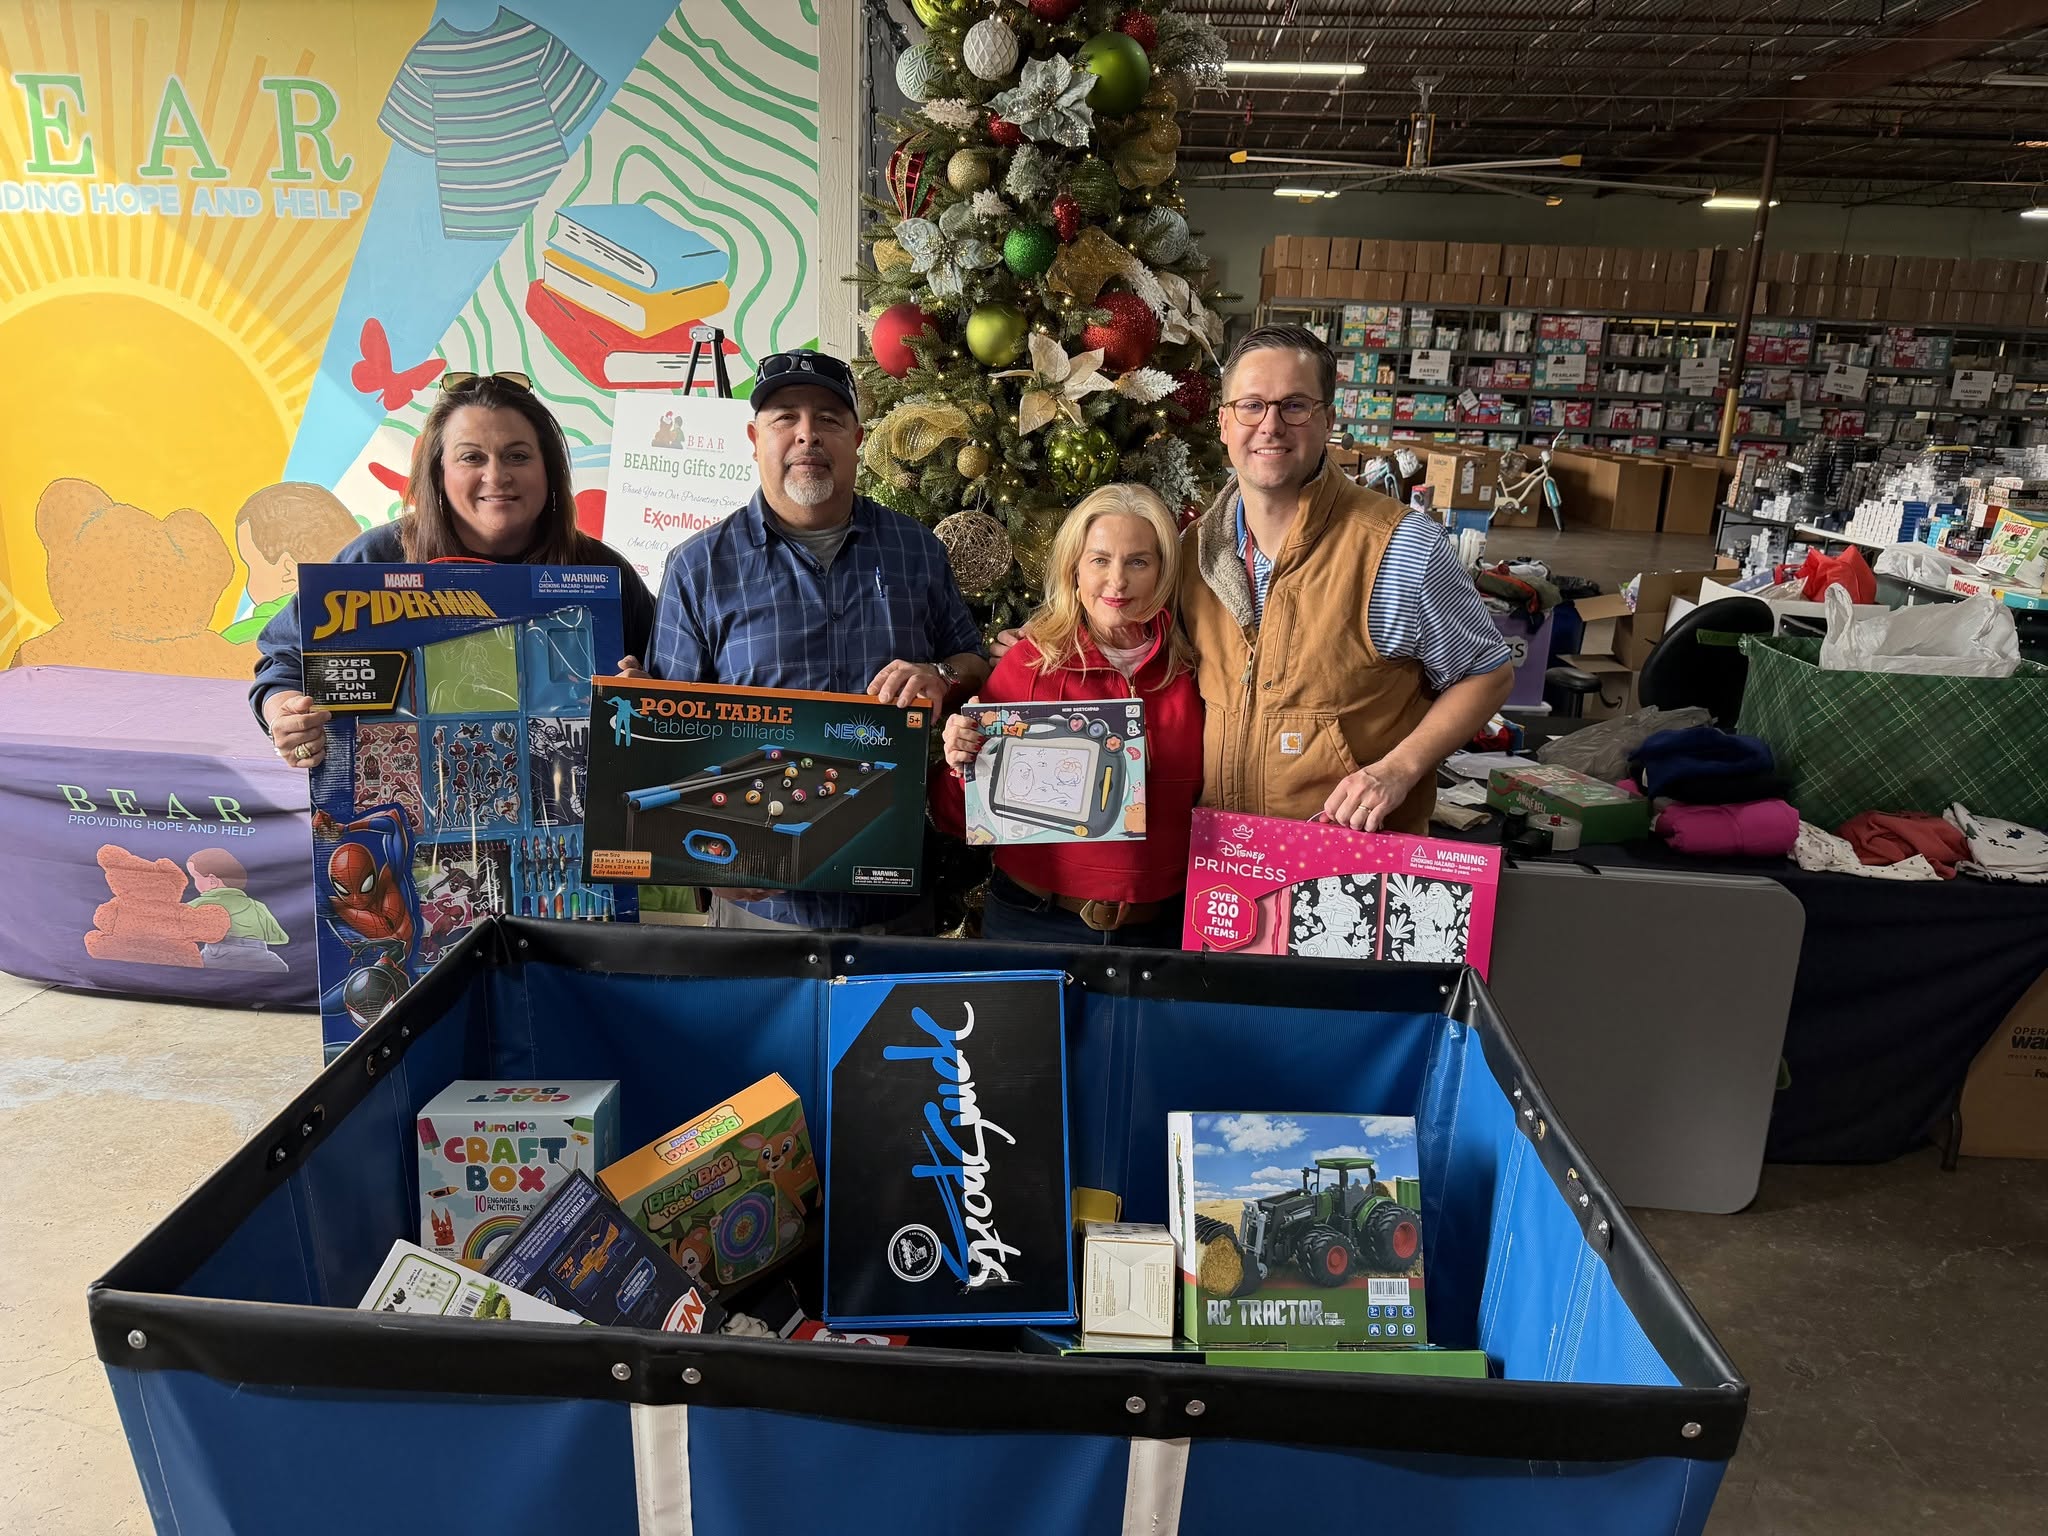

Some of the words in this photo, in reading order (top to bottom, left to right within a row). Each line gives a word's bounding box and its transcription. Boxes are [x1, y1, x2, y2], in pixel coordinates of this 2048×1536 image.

[90, 182, 181, 216] HOPE
[192, 186, 262, 218] AND
[274, 187, 362, 219] HELP
[687, 435, 725, 450] BEAR
[624, 452, 680, 478] BEARing
[683, 459, 716, 478] Gifts
[719, 463, 752, 482] 2025
[2002, 521, 2031, 536] HUGGIES
[384, 573, 424, 588] MARVEL
[562, 573, 608, 583] WARNING:
[312, 590, 498, 640] SPIDER-MAN
[327, 659, 371, 667] OVER
[324, 668, 376, 681] 200
[335, 682, 366, 691] FUN
[325, 691, 377, 701] ITEMS!
[639, 697, 711, 719] POOL
[716, 703, 793, 724] TABLE
[653, 717, 723, 739] tabletop
[731, 722, 795, 741] billiards
[909, 715, 921, 725] 5+
[824, 722, 886, 740] NEON
[56, 784, 252, 824] BEAR
[68, 814, 143, 830] PROVIDING
[147, 821, 183, 832] HOPE
[188, 823, 217, 834] AND
[221, 825, 256, 837] HELP
[1433, 860, 1455, 868] HAZARD
[1436, 850, 1488, 866] WARNING:
[1194, 856, 1287, 882] PRINCESS
[1209, 890, 1238, 904] OVER
[1207, 902, 1239, 918] 200
[1211, 917, 1233, 928] FUN
[1204, 926, 1239, 940] ITEMS!
[466, 1094, 571, 1102] CRAFT
[695, 1116, 741, 1147] BEAN
[697, 1115, 726, 1133] TOSS
[669, 1129, 698, 1148] GAME
[443, 1136, 568, 1165] CRAFT
[665, 1138, 700, 1161] BAG
[465, 1164, 547, 1193] BOX
[649, 1173, 698, 1214] BEAN
[697, 1156, 734, 1186] BAG
[474, 1195, 487, 1213] 10
[487, 1197, 519, 1205] ENGAGING
[659, 1195, 693, 1219] TOSS
[692, 1176, 726, 1201] GAME
[487, 1203, 520, 1212] ACTIVITIES
[522, 1204, 536, 1212] INS
[1207, 1299, 1232, 1326] RC
[1237, 1299, 1324, 1326] TRACTOR
